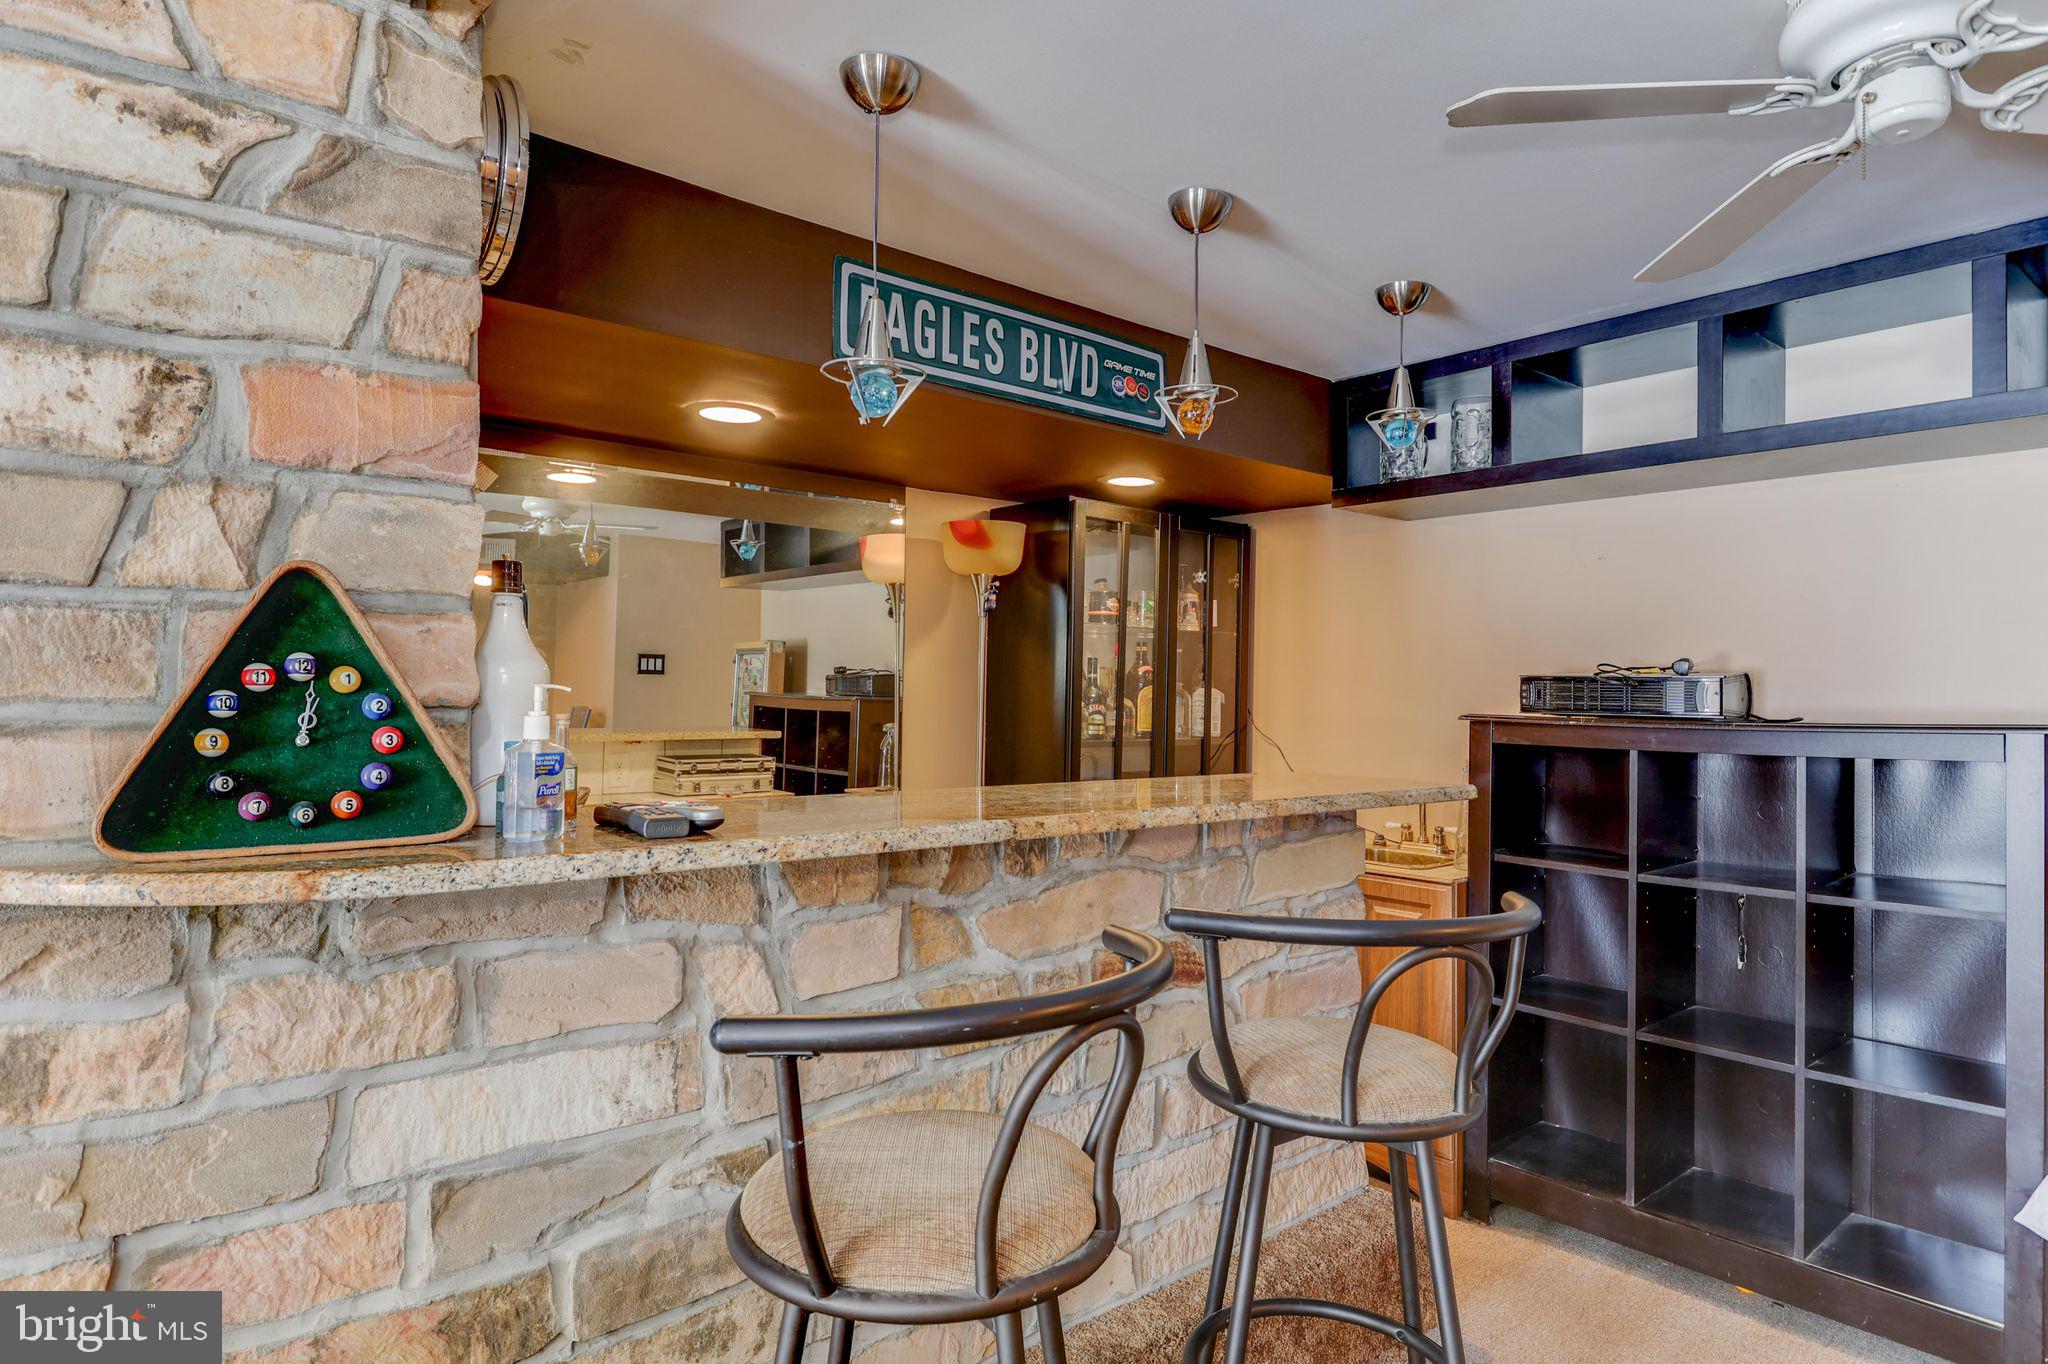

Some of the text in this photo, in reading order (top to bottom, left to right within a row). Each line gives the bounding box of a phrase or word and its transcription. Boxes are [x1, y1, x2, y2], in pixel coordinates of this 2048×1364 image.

[1020, 326, 1099, 398] BLVD
[1103, 359, 1157, 381] GAME TIME
[296, 659, 311, 672] 12
[253, 670, 267, 683] 11
[217, 697, 232, 709] 10
